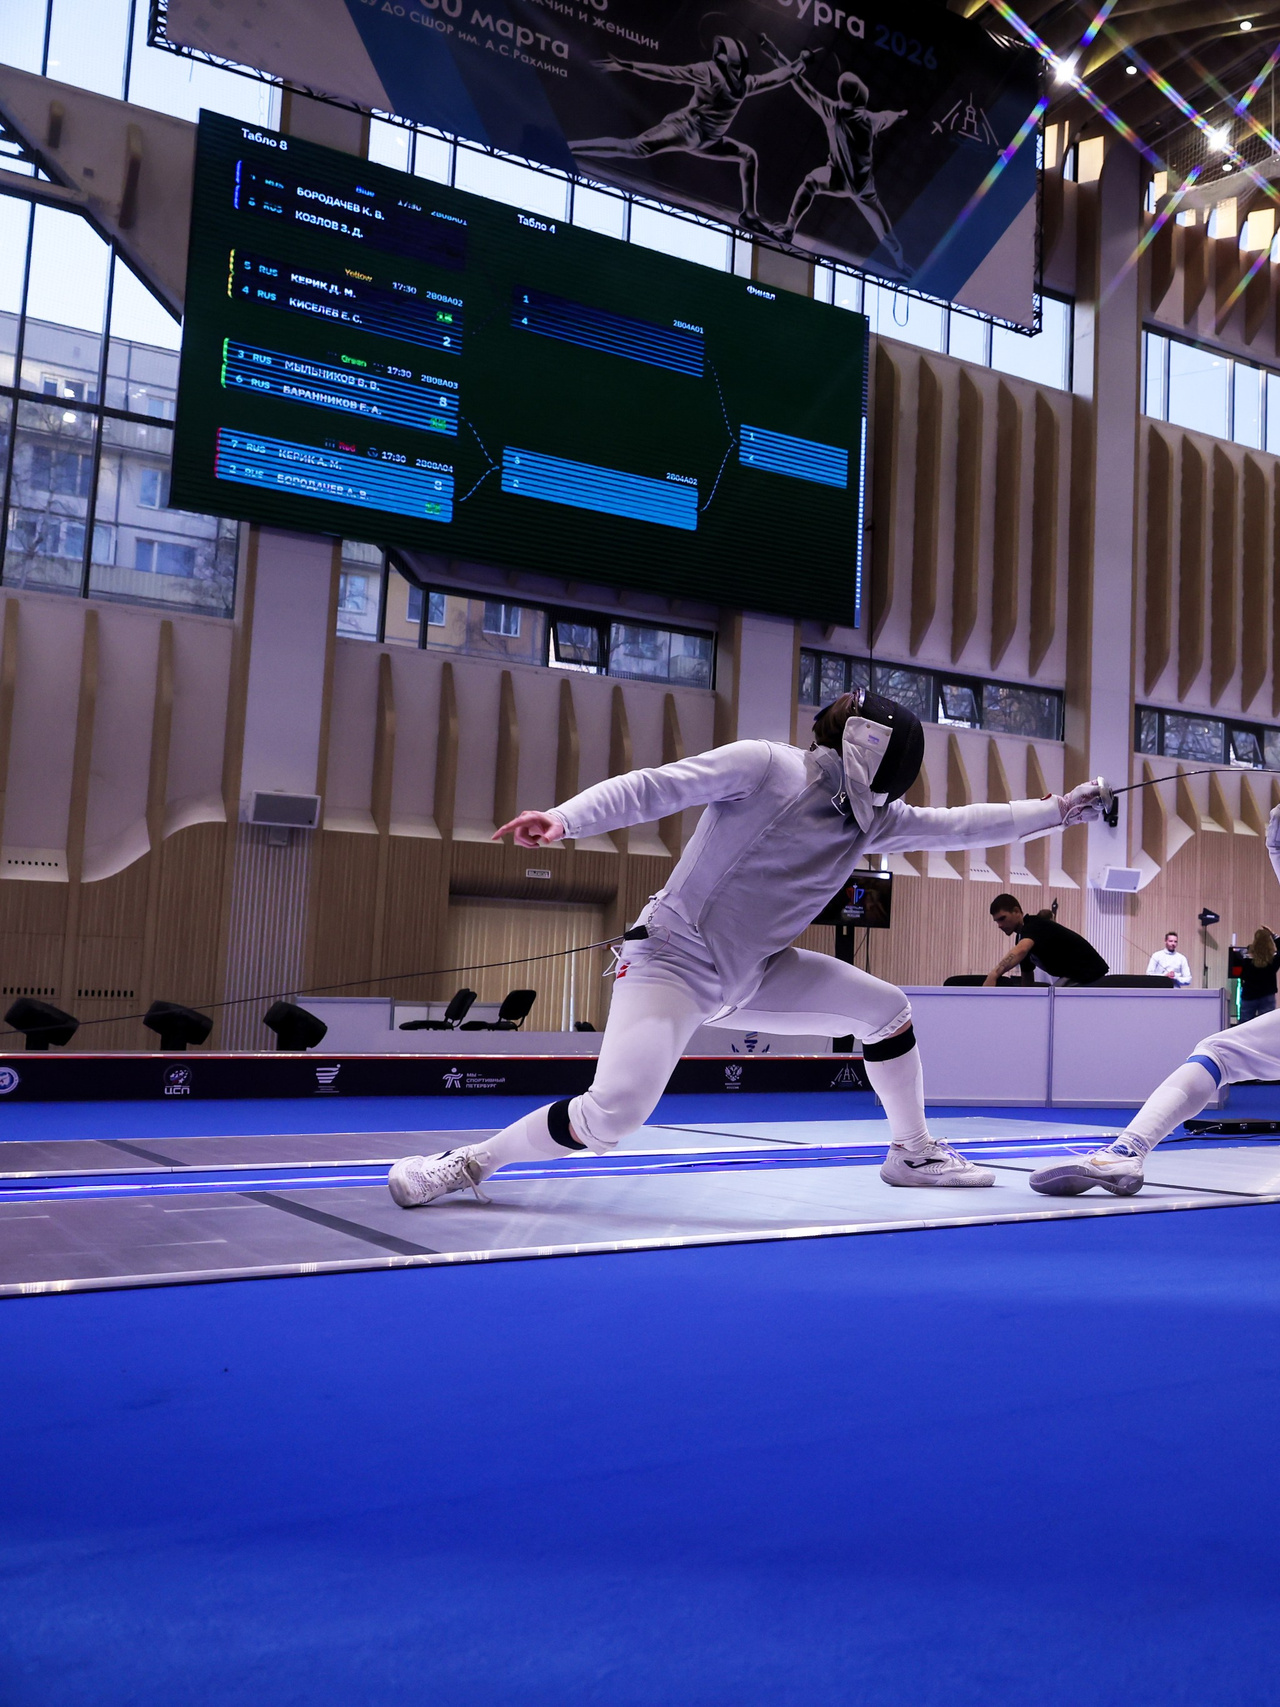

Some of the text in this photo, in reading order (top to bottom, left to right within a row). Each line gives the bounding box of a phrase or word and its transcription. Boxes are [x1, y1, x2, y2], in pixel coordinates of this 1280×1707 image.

[381, 4, 568, 78] ДО СШОР им. А.С.Рахлина
[470, 9, 569, 60] марта
[592, 16, 659, 50] женщин
[874, 24, 938, 70] 2026
[241, 127, 288, 150] Табло 8
[296, 186, 361, 213] БОРОДАЧЕВ
[362, 206, 373, 217] К.
[374, 210, 385, 220] В.
[294, 210, 339, 231] КОЗЛОВ
[352, 227, 364, 239] Д.
[517, 214, 556, 235] Табло 4
[243, 260, 252, 271] 5
[258, 264, 279, 278] RUS
[290, 273, 328, 292] КЕРИК
[328, 283, 342, 296] Д.
[343, 288, 357, 299] М.
[392, 281, 417, 295] 17:30
[344, 268, 373, 283] Yellow
[241, 284, 363, 325] 4 RUS КИСЕЛЕВ Е. С.
[522, 294, 529, 304] 1
[746, 284, 776, 301] Финал
[521, 316, 529, 326] 4
[442, 335, 452, 348] 2
[237, 349, 245, 360] 3
[252, 352, 273, 366] RUS
[284, 360, 356, 387] МЫЛЬНИКОВ
[369, 380, 381, 391] В.
[386, 365, 413, 379] 17:30
[340, 353, 368, 368] Green
[235, 373, 244, 384] 6
[250, 377, 271, 391] RUS
[282, 384, 358, 411] БАРАННИКОВ
[370, 404, 383, 416] А.
[438, 396, 449, 408] 8
[230, 438, 239, 449] 7
[278, 448, 316, 465] КЕРИК
[328, 460, 343, 471] М.
